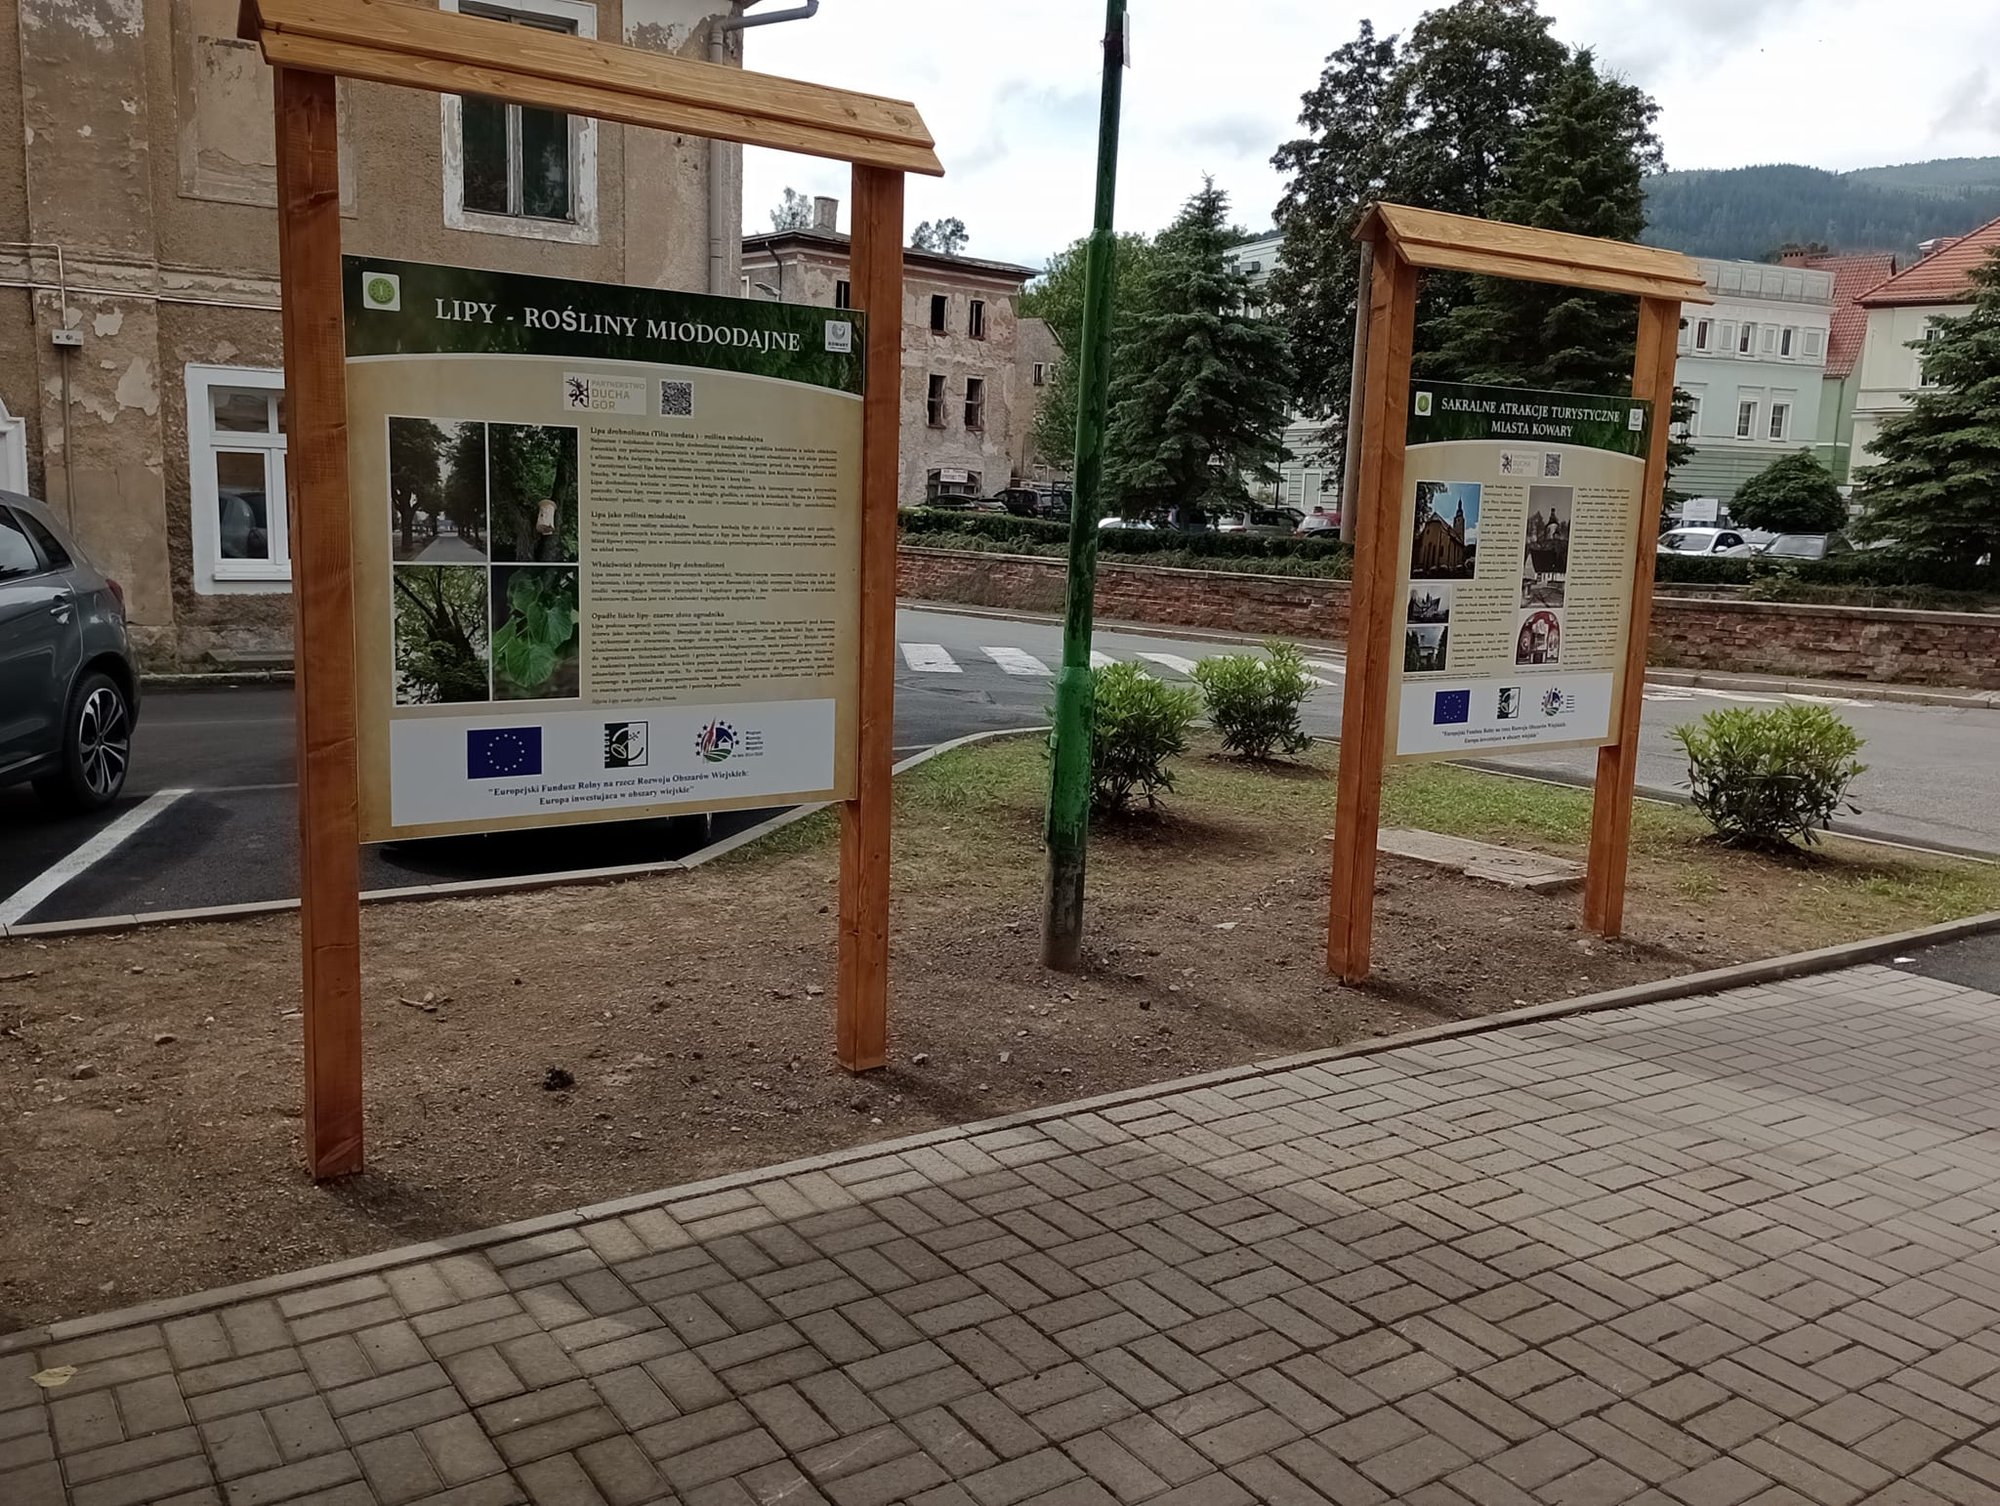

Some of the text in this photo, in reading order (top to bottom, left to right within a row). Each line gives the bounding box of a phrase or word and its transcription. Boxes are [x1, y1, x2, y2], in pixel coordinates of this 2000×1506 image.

[435, 298, 497, 324] LIPY
[523, 305, 639, 337] ROŚLINY
[646, 319, 800, 354] MIODODAJNE
[592, 389, 630, 399] DUCHA
[1441, 398, 1621, 422] SAKRALNE ATRAKCJE TURYSTYCZNE
[1491, 420, 1574, 438] MIASTA KOWARY
[541, 783, 576, 793] Fundusz
[578, 780, 601, 790] Rolny
[615, 779, 635, 787] rzecz
[637, 776, 671, 785] Rozwoju
[672, 774, 709, 782] Obszarów
[540, 796, 569, 806] Europa
[628, 789, 657, 799] obszary
